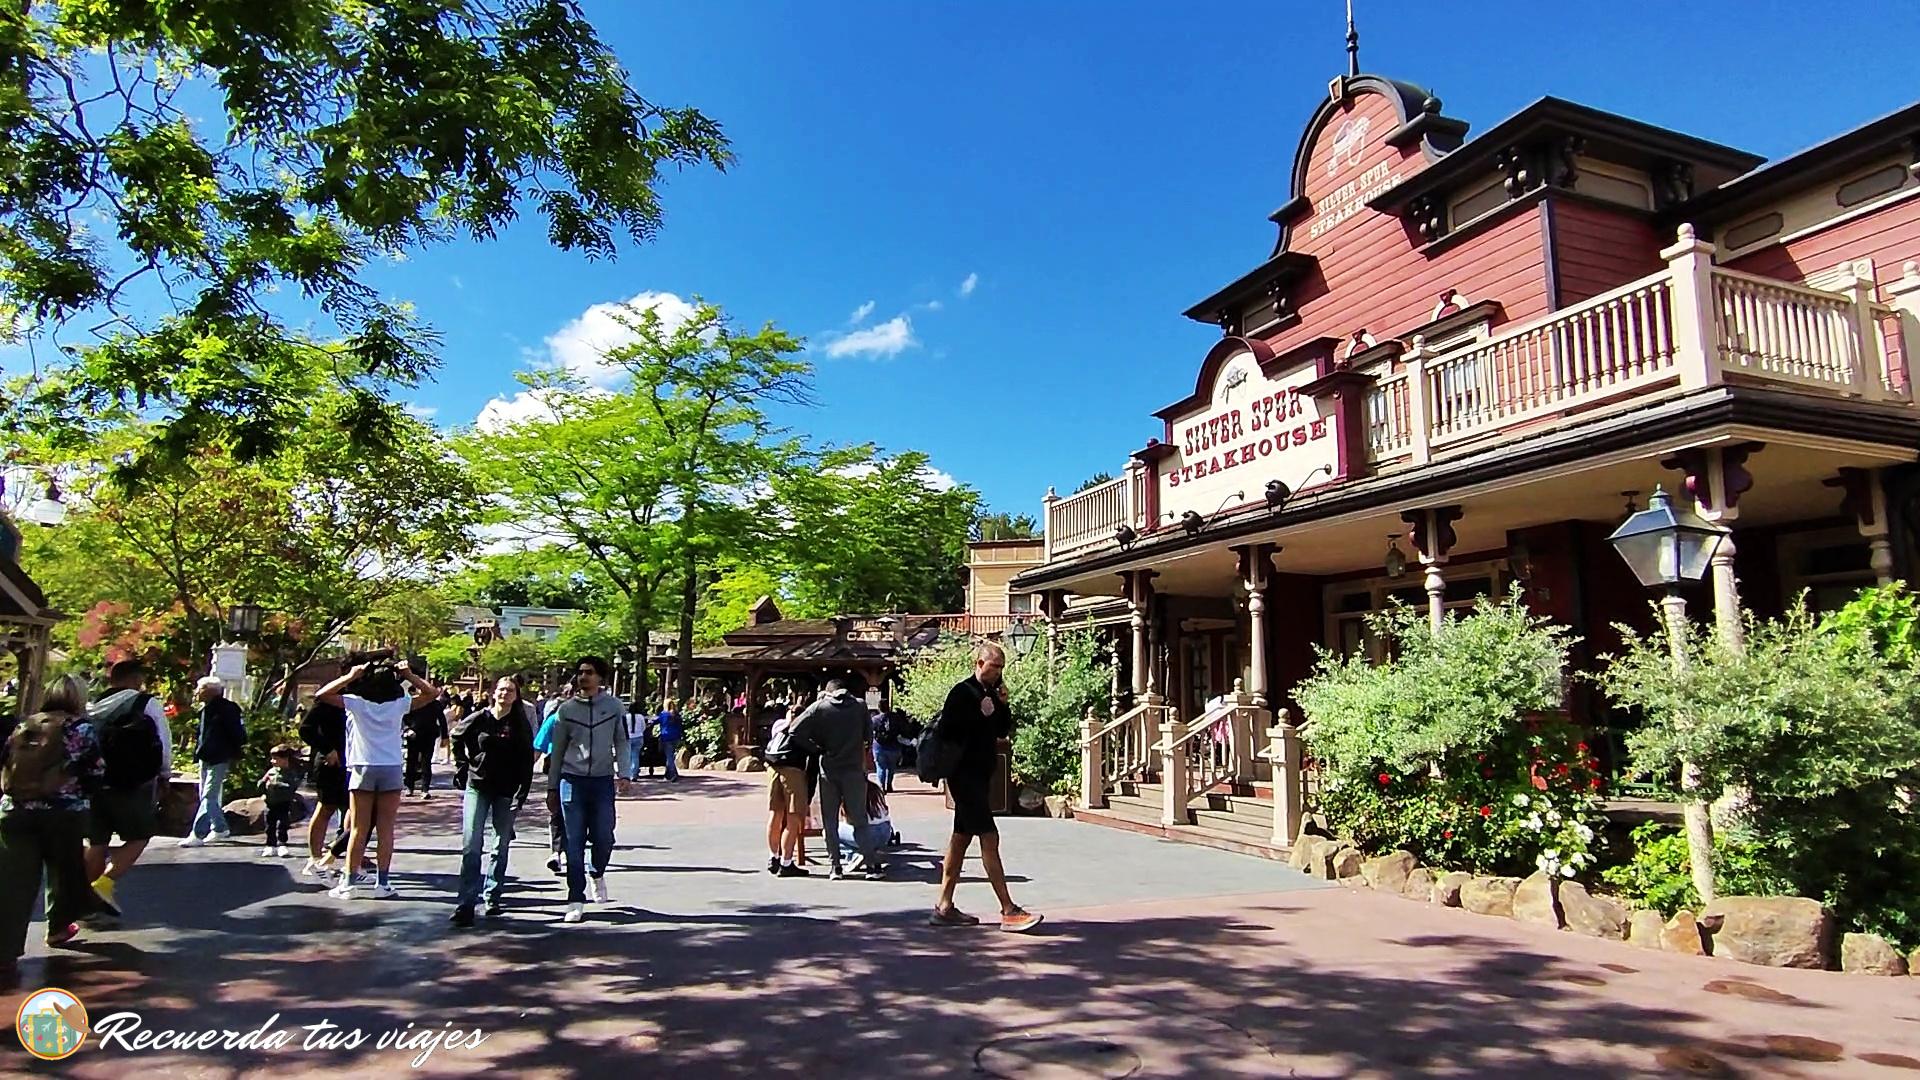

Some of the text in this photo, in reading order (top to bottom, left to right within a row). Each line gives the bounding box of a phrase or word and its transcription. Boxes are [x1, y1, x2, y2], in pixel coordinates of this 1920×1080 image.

[1318, 160, 1389, 215] SILVER SPUR
[1169, 416, 1328, 488] STEAKHOUSE
[1185, 386, 1303, 457] SILVER SPUR
[846, 631, 895, 642] CAFE
